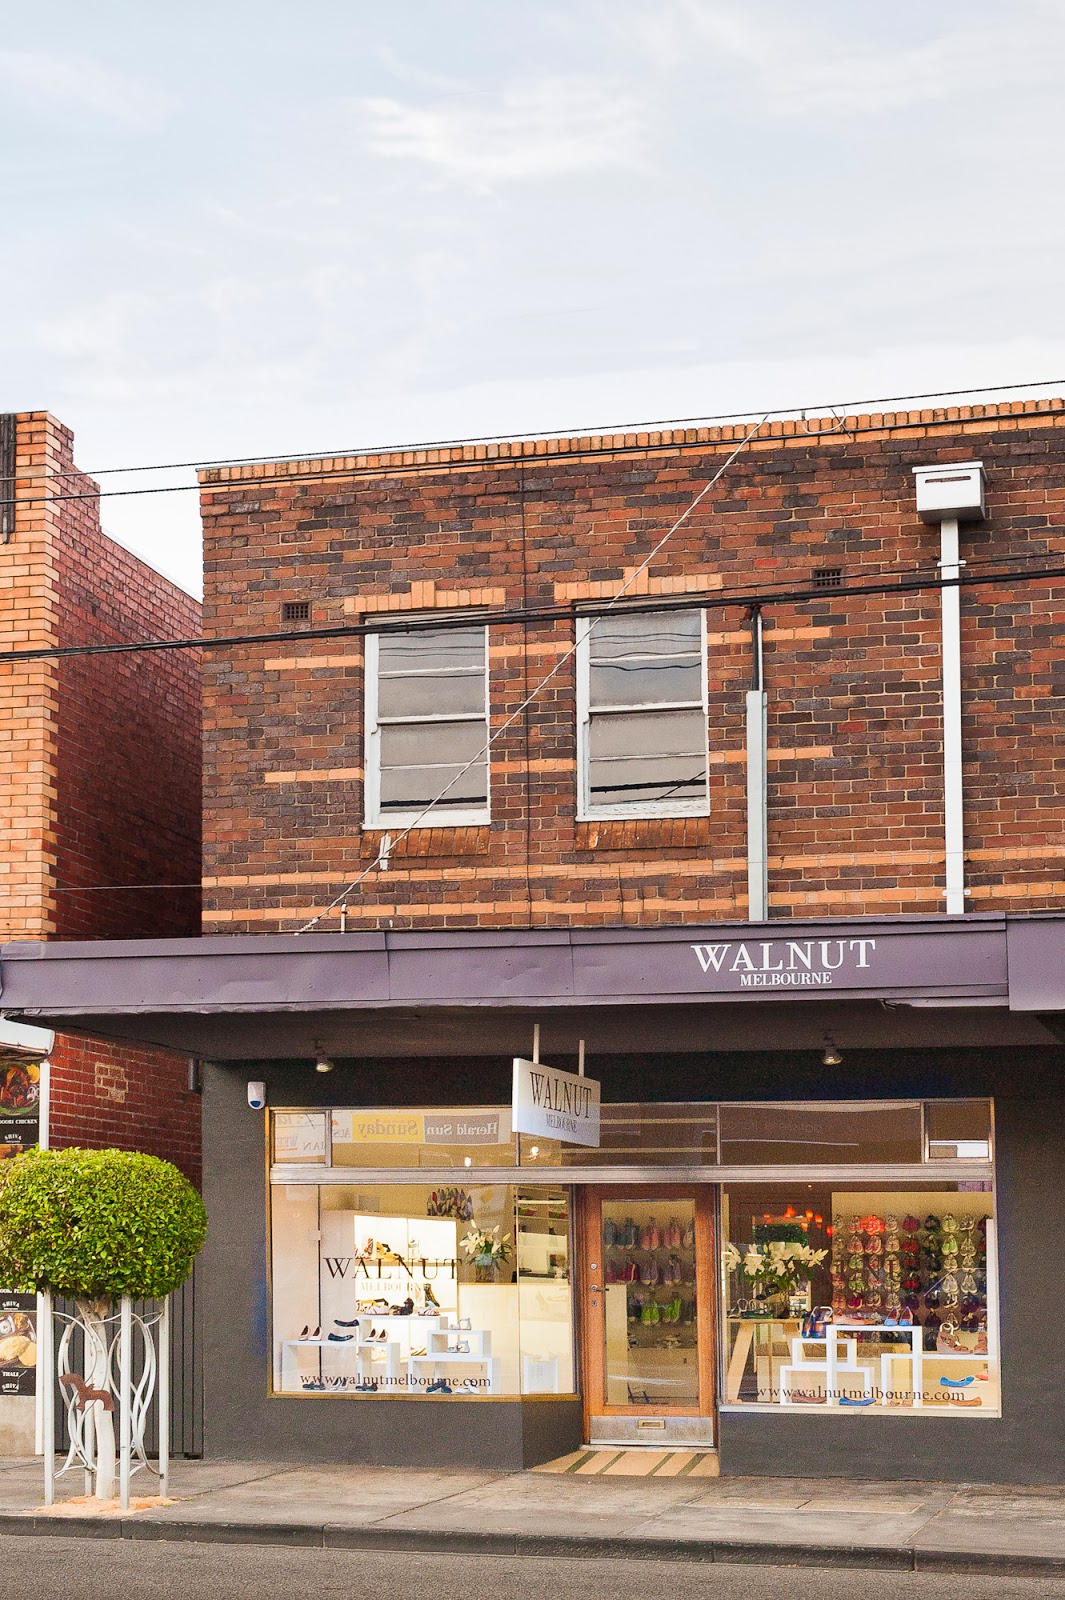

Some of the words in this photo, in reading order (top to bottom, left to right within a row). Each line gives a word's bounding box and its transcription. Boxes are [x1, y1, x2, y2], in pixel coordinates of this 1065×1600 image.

[690, 939, 876, 972] WALNUT
[740, 972, 832, 986] MELBOURNE
[529, 1071, 592, 1118] WALNUT
[323, 1257, 463, 1280] WALNUT
[361, 1282, 424, 1292] MELBOURN
